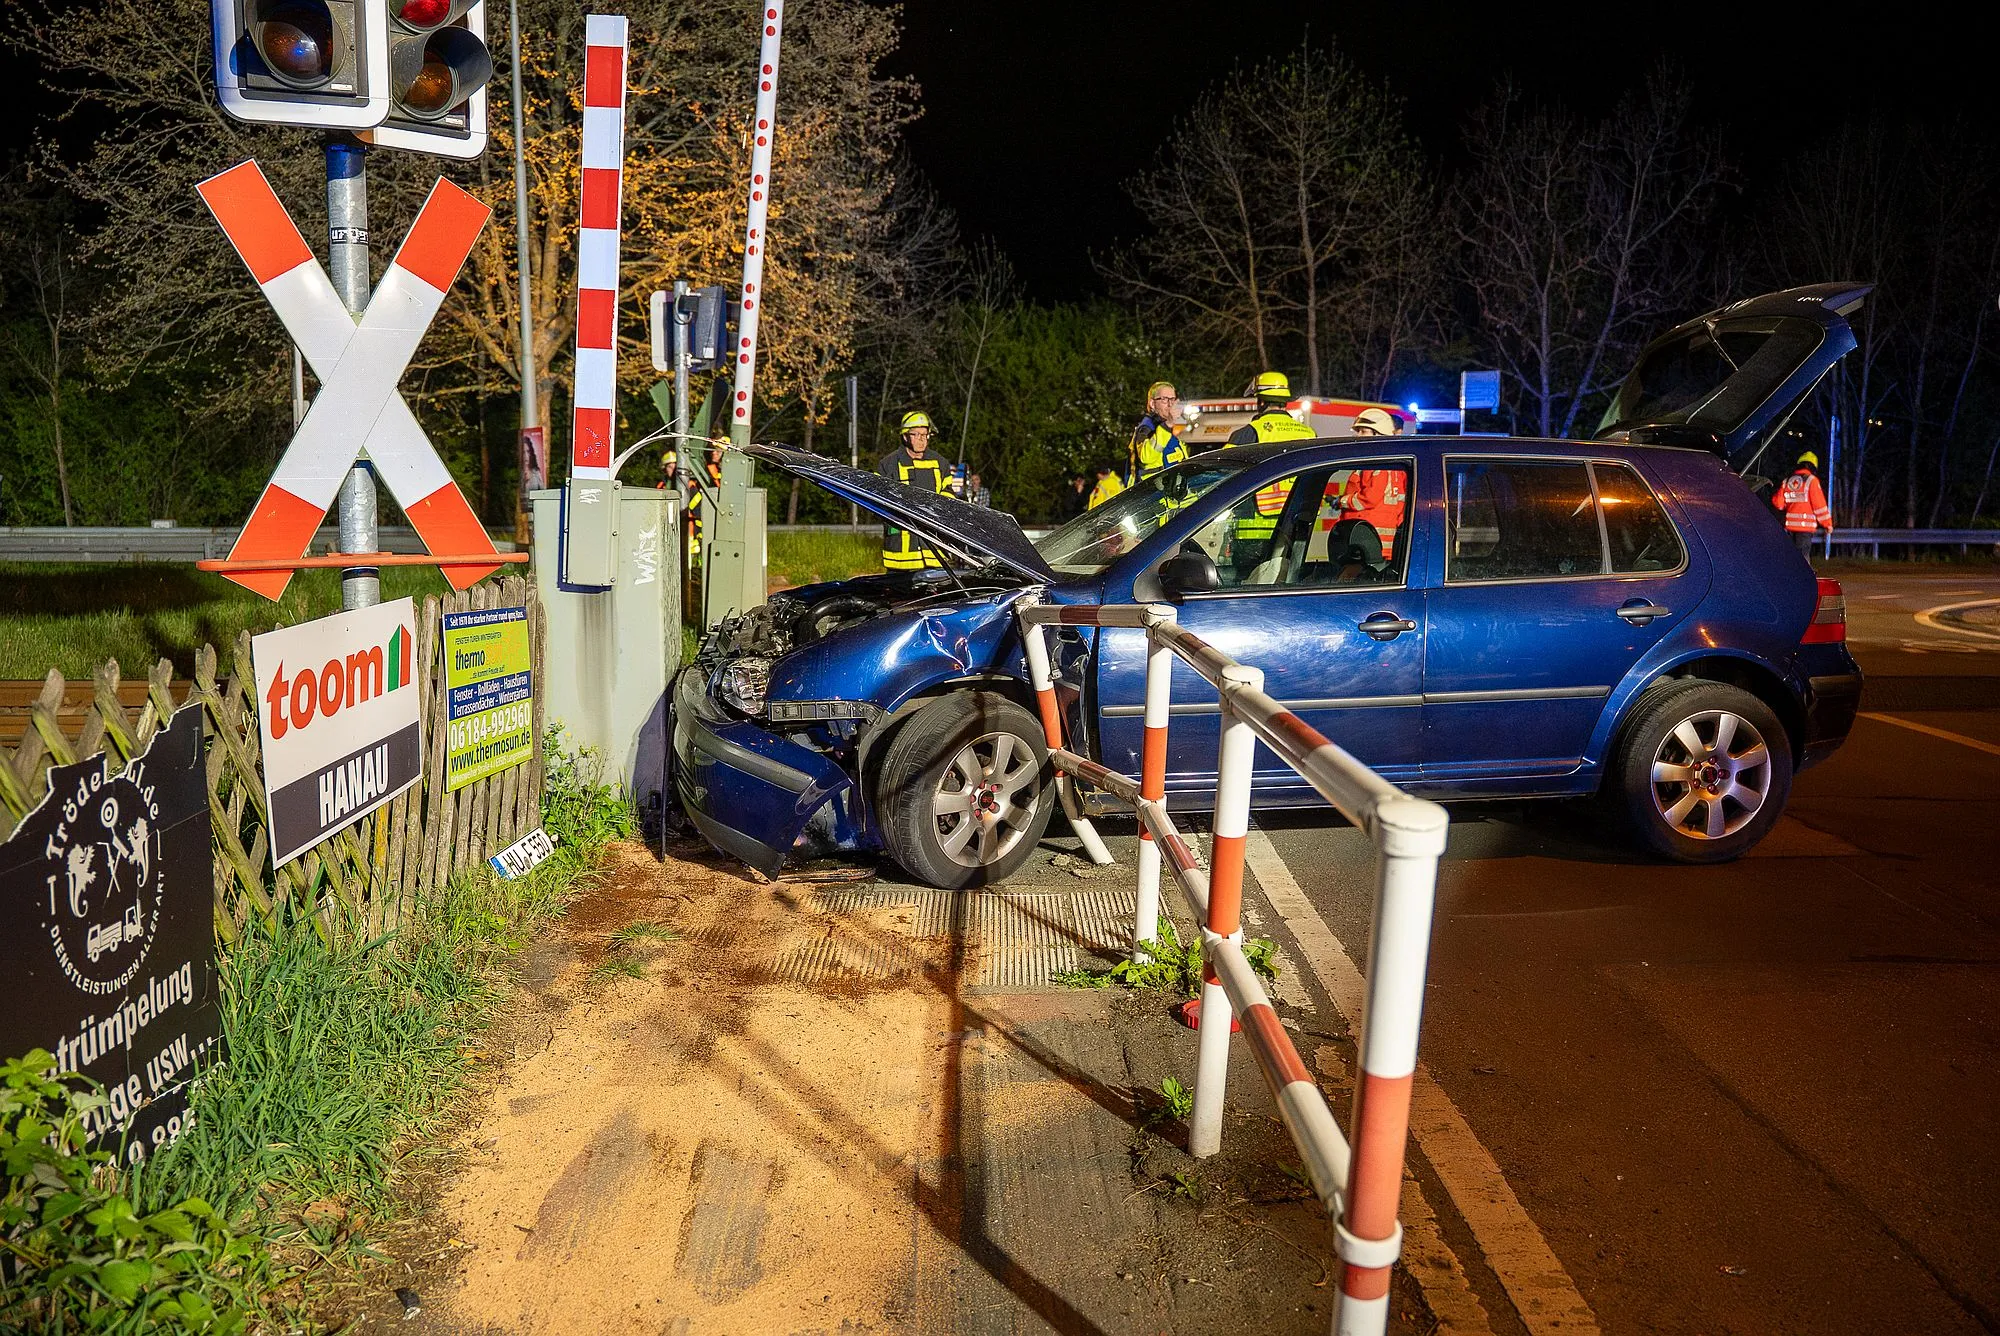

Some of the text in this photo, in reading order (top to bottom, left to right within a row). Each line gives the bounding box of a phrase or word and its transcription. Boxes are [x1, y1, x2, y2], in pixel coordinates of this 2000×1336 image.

[266, 645, 384, 740] toom
[454, 687, 474, 703] Fenster
[503, 674, 528, 689] Haustüren
[498, 687, 529, 704] Wintergärten
[450, 701, 531, 752] 06184-992960
[451, 728, 531, 773] www.thermosun.de
[319, 743, 389, 828] HANAU
[527, 833, 550, 860] 550
[51, 871, 165, 995] DIENSTLEISTUNGEN ALLER ART
